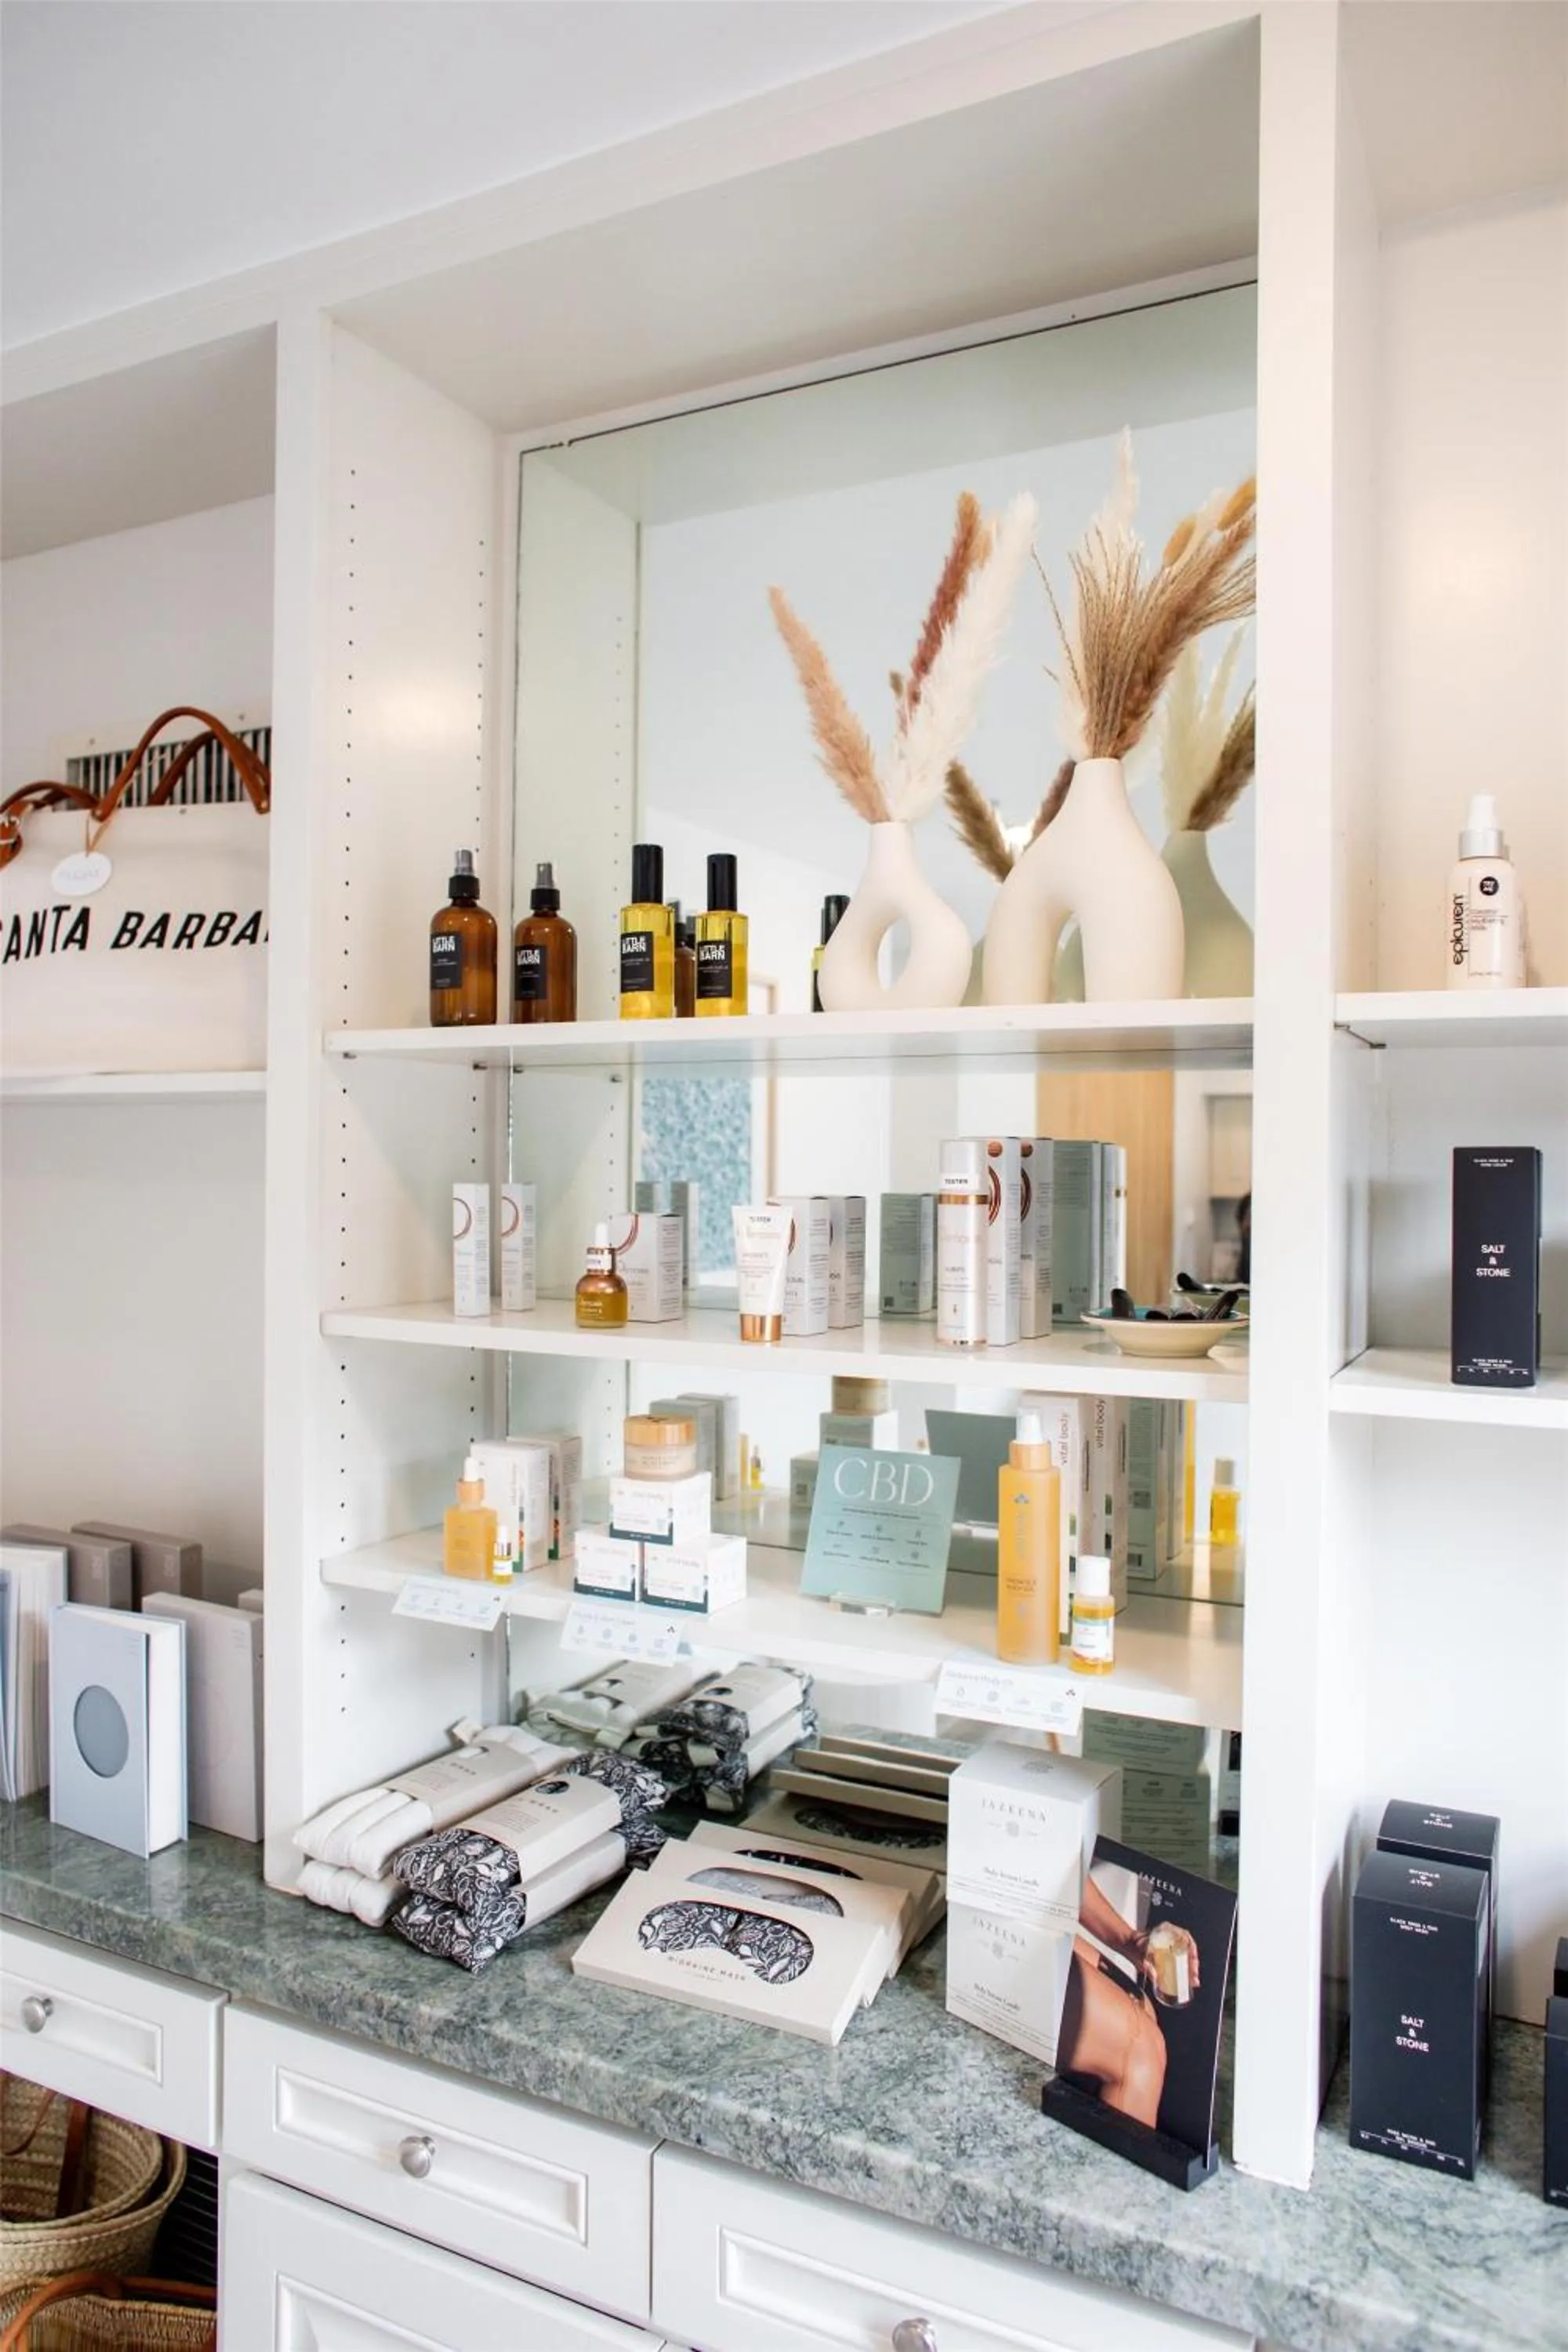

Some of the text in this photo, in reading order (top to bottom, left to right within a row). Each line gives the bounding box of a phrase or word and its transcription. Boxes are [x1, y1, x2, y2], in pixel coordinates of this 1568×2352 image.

[0, 905, 268, 964] ANTA BARBA
[1450, 894, 1468, 965] epicuren
[432, 943, 455, 953] BARN
[621, 943, 647, 954] BARN
[517, 956, 539, 966] BARN
[699, 951, 725, 961] BARN
[1481, 1244, 1506, 1254] SALT
[1476, 1268, 1511, 1277] STONE
[1094, 1399, 1106, 1423] body
[833, 1457, 935, 1506] CBD
[982, 1798, 1047, 1823] JAZEENA
[1401, 2014, 1425, 2028] SALT
[1396, 2036, 1429, 2053] STONE
